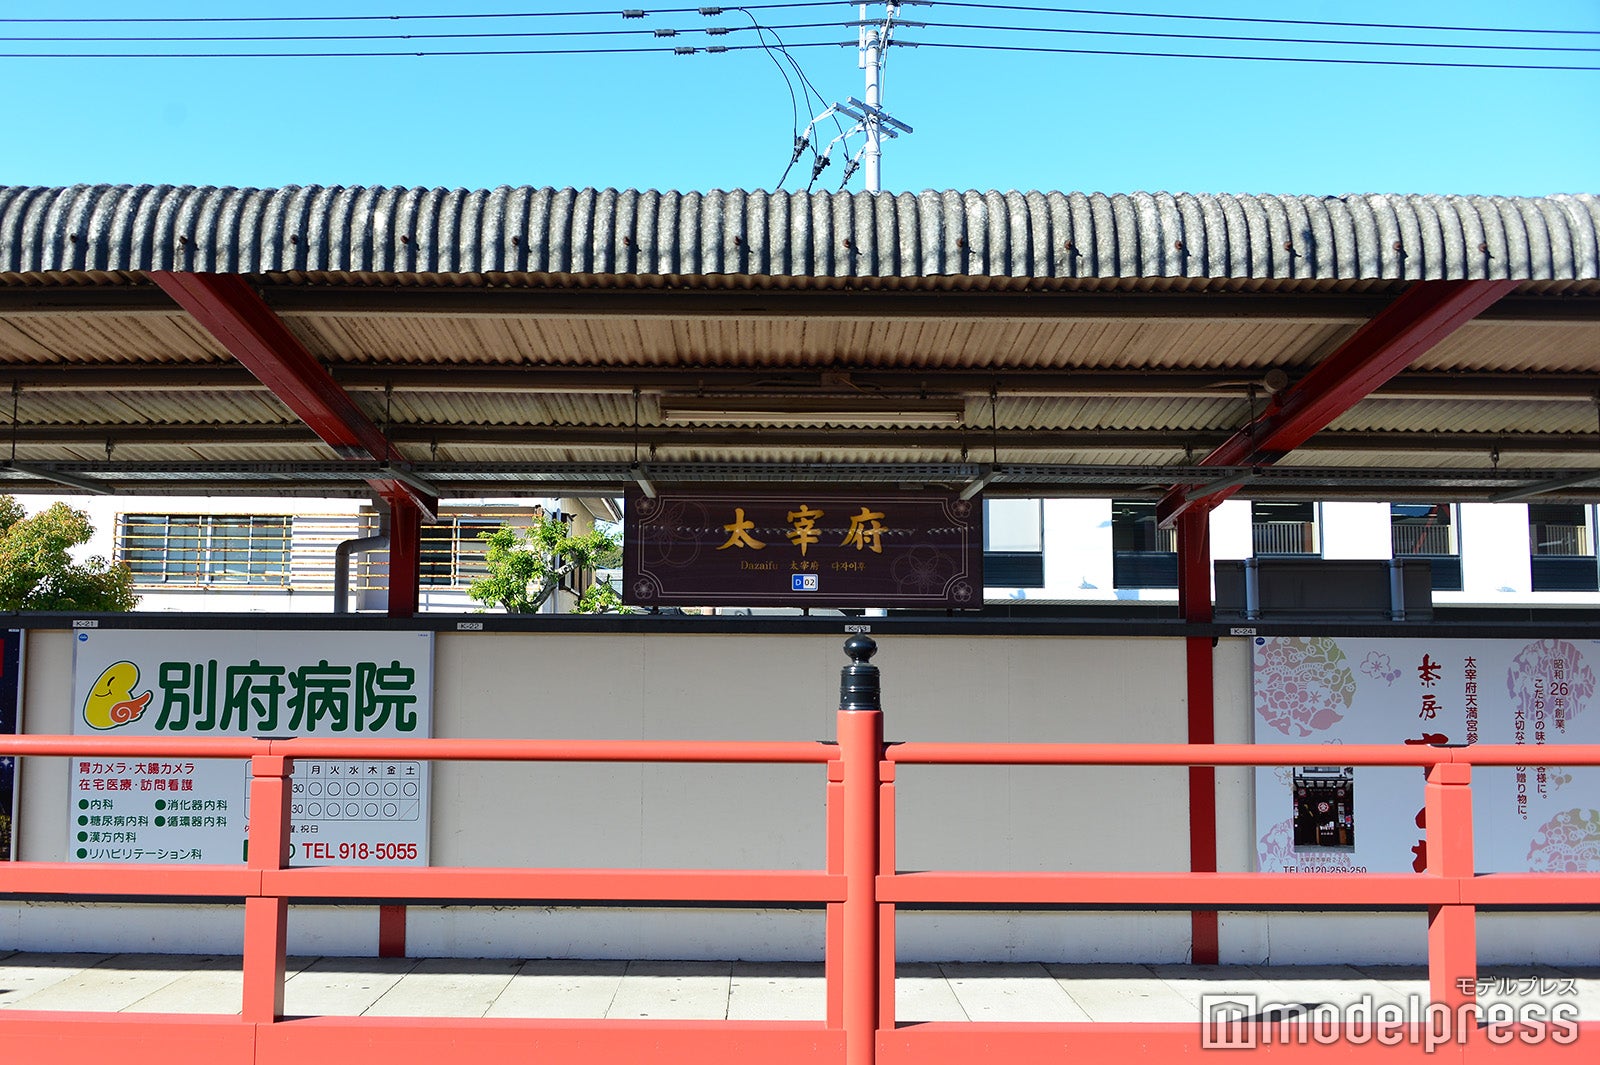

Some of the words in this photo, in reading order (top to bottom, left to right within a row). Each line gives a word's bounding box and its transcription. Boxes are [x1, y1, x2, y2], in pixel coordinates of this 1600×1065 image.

[716, 504, 890, 557] 太宰府
[740, 560, 779, 571] Dazaifu
[789, 560, 820, 571] 太宰府
[831, 561, 866, 572] 다자이후
[804, 578, 815, 587] 02
[154, 658, 418, 733] 別府病院
[311, 765, 321, 775] 月
[330, 766, 340, 775] 火
[348, 766, 359, 775] 水
[367, 766, 378, 775] 木
[386, 766, 397, 775] 金
[405, 766, 415, 776] 土
[90, 799, 114, 810] 内科
[167, 799, 228, 811] 消化器内科
[89, 815, 149, 827] 糖尿病内科
[167, 815, 228, 827] 循環器内科
[89, 831, 137, 843] 漢方内科
[89, 848, 202, 860] リハビリテーション科
[302, 843, 335, 859] TEL
[339, 842, 417, 860] 918-5055
